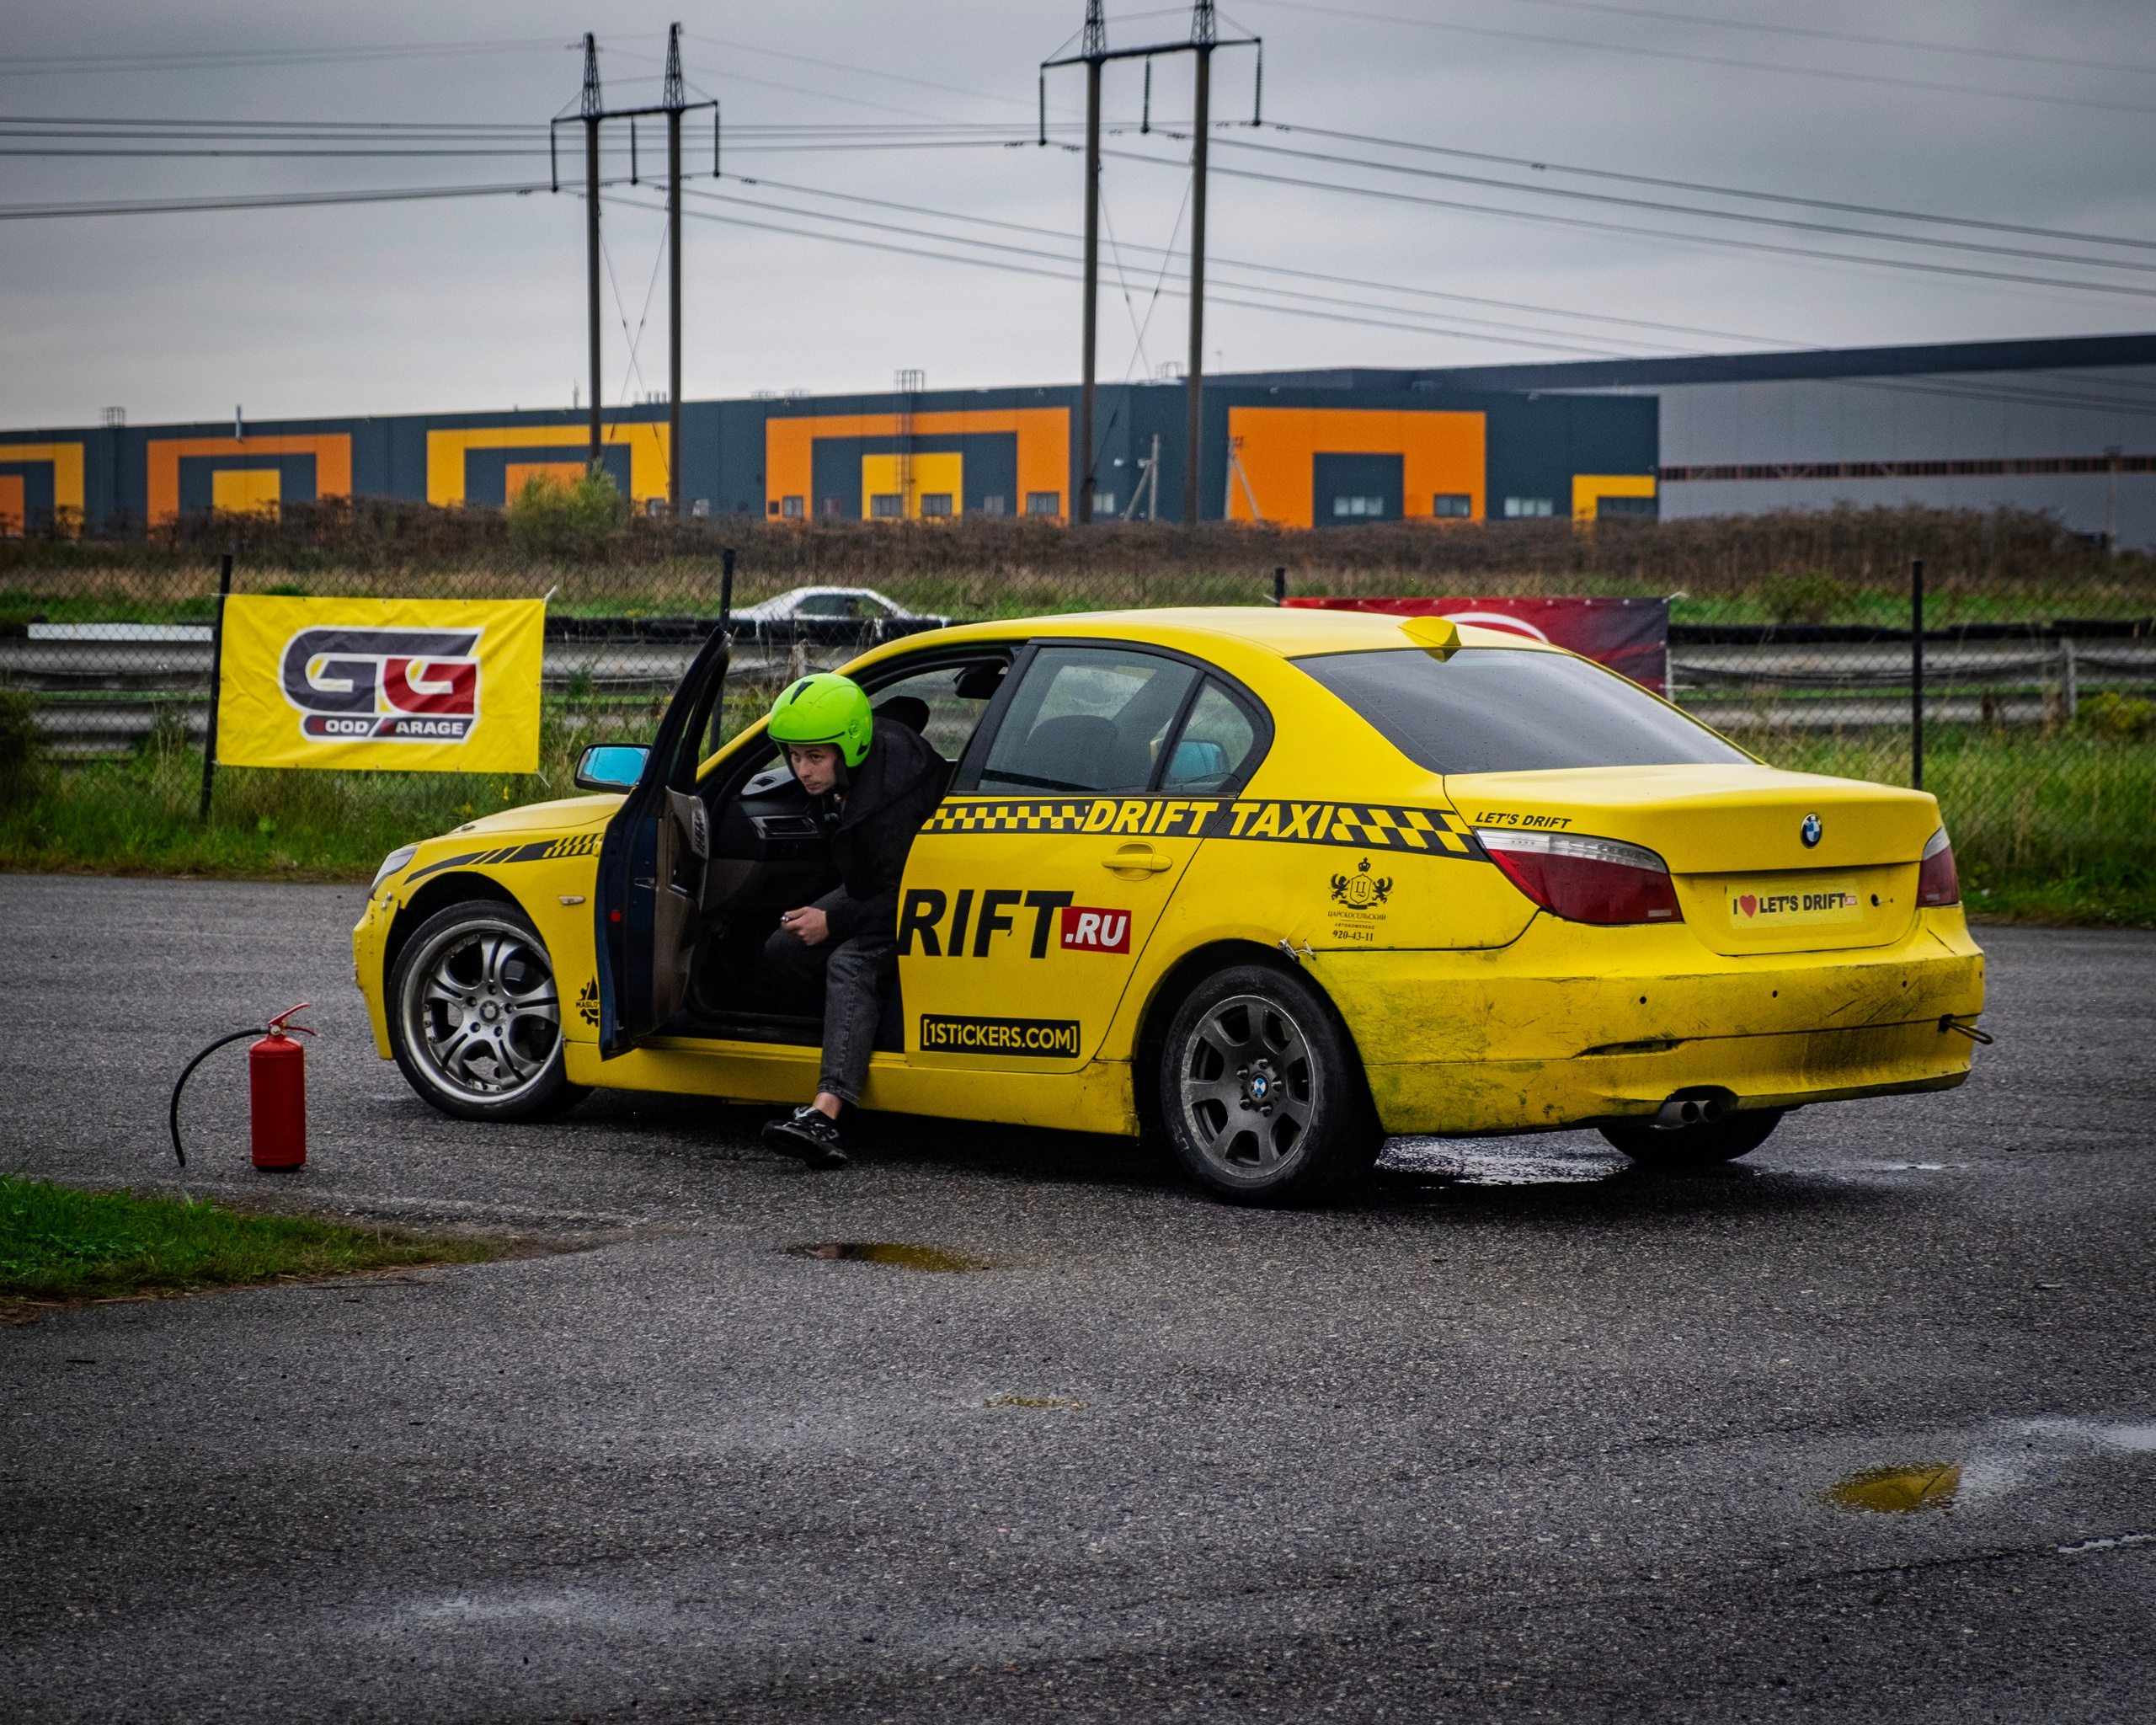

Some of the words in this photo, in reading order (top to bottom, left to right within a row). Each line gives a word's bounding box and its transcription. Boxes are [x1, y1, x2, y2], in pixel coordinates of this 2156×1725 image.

[311, 718, 369, 734] OOD
[382, 719, 463, 735] ARAGE
[1082, 800, 1219, 835] DRIFT
[1230, 803, 1335, 839] TAXI
[1476, 812, 1519, 825] LET'S
[1522, 815, 1572, 829] DRIFT
[1733, 899, 1737, 915] I
[1759, 895, 1798, 913] LET'S
[1803, 893, 1845, 911] DRIFT
[1332, 930, 1374, 942] 920-43-11
